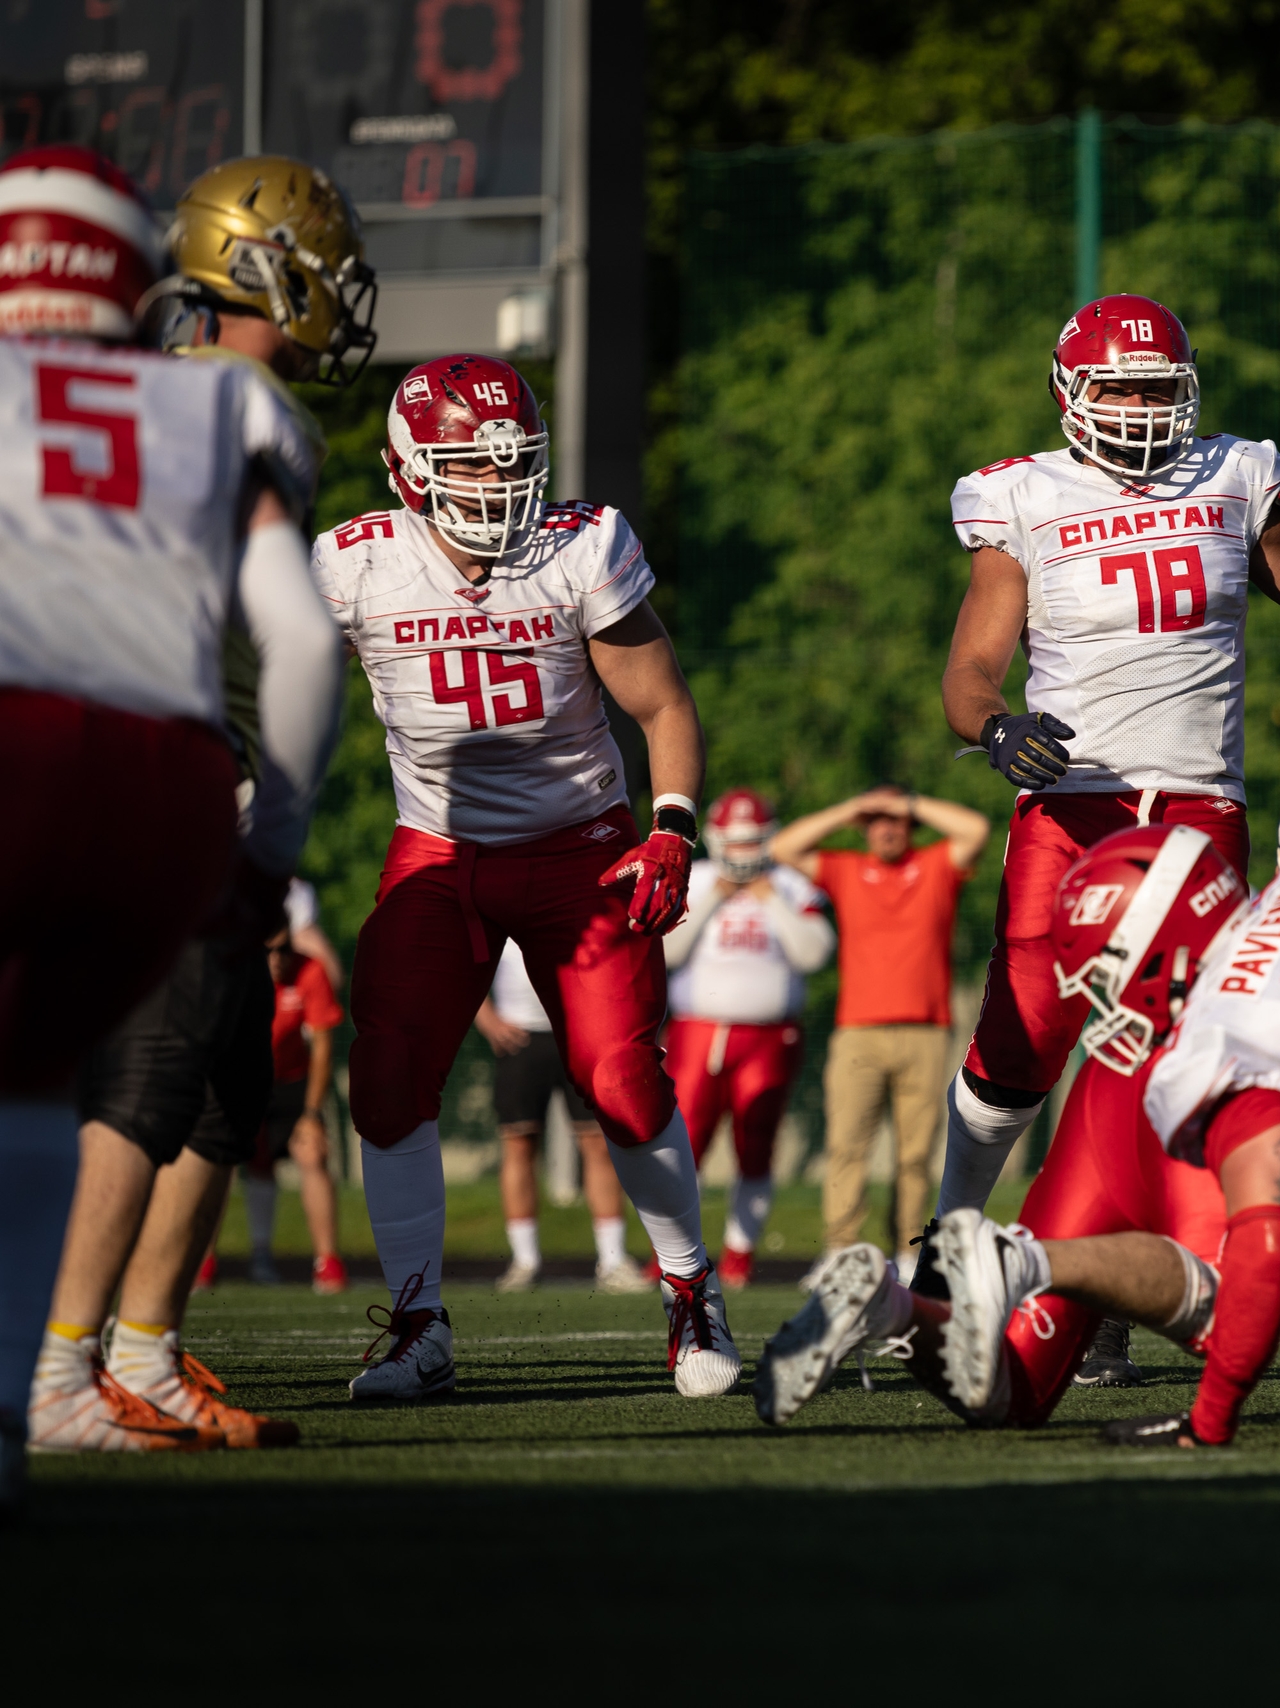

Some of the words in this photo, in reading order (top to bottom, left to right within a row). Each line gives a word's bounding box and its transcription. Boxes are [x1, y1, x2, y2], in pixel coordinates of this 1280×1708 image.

[1121, 319, 1154, 342] 78
[472, 381, 509, 406] 45
[34, 361, 141, 513] 5
[1099, 544, 1207, 634] 78
[429, 647, 545, 730] 45
